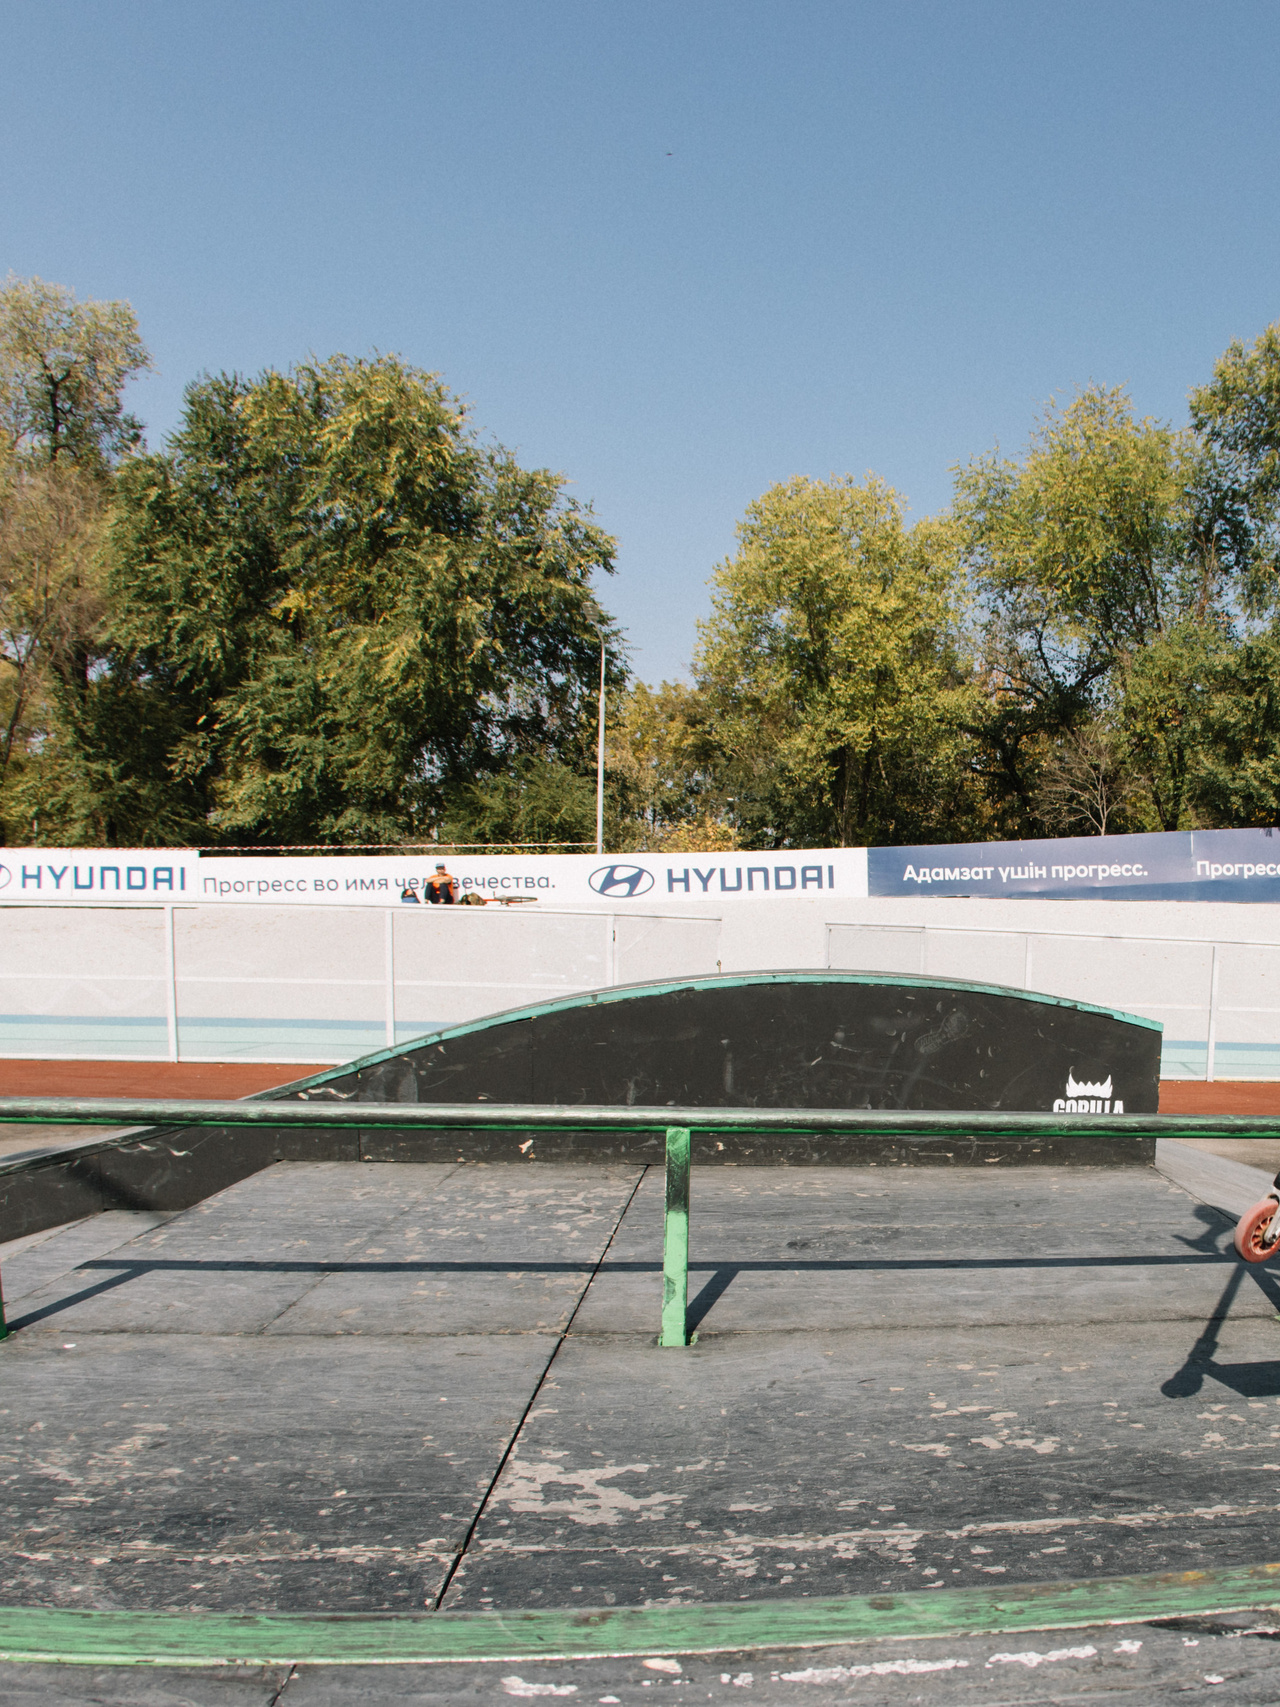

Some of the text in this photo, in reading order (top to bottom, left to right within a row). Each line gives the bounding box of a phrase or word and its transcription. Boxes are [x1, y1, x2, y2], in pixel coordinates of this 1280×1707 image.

[21, 865, 186, 891] HYUNDAI
[667, 865, 835, 893] HYUNDAI
[903, 862, 1148, 884] Адамзат үшін прогресс.
[203, 877, 308, 896] Прогресс
[313, 878, 339, 892] во
[345, 877, 389, 891] имя
